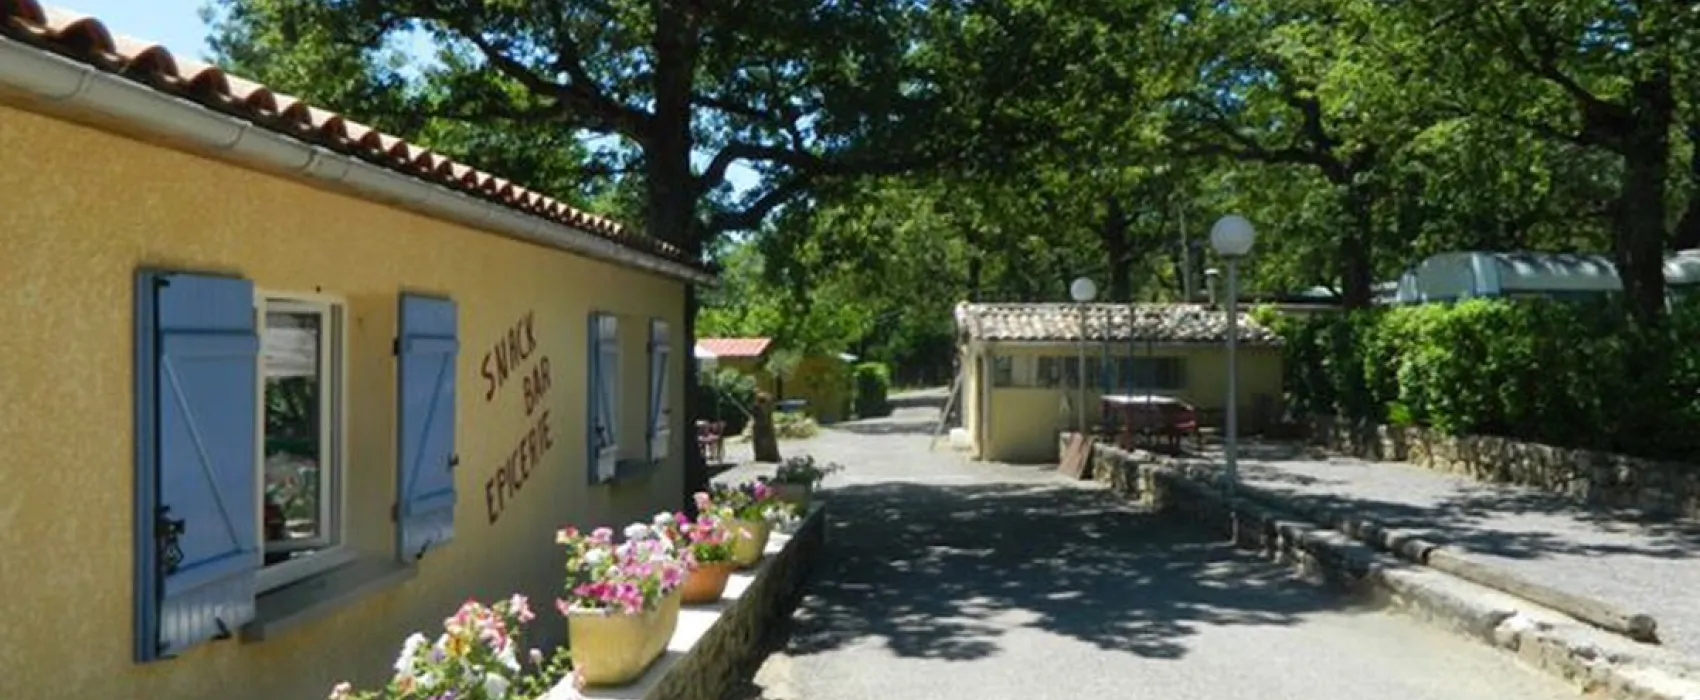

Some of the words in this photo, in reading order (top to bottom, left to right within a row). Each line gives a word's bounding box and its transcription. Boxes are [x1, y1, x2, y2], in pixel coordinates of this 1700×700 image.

[481, 309, 537, 402] SNACK
[523, 355, 552, 416] BAR
[485, 410, 553, 526] EPICERIE
